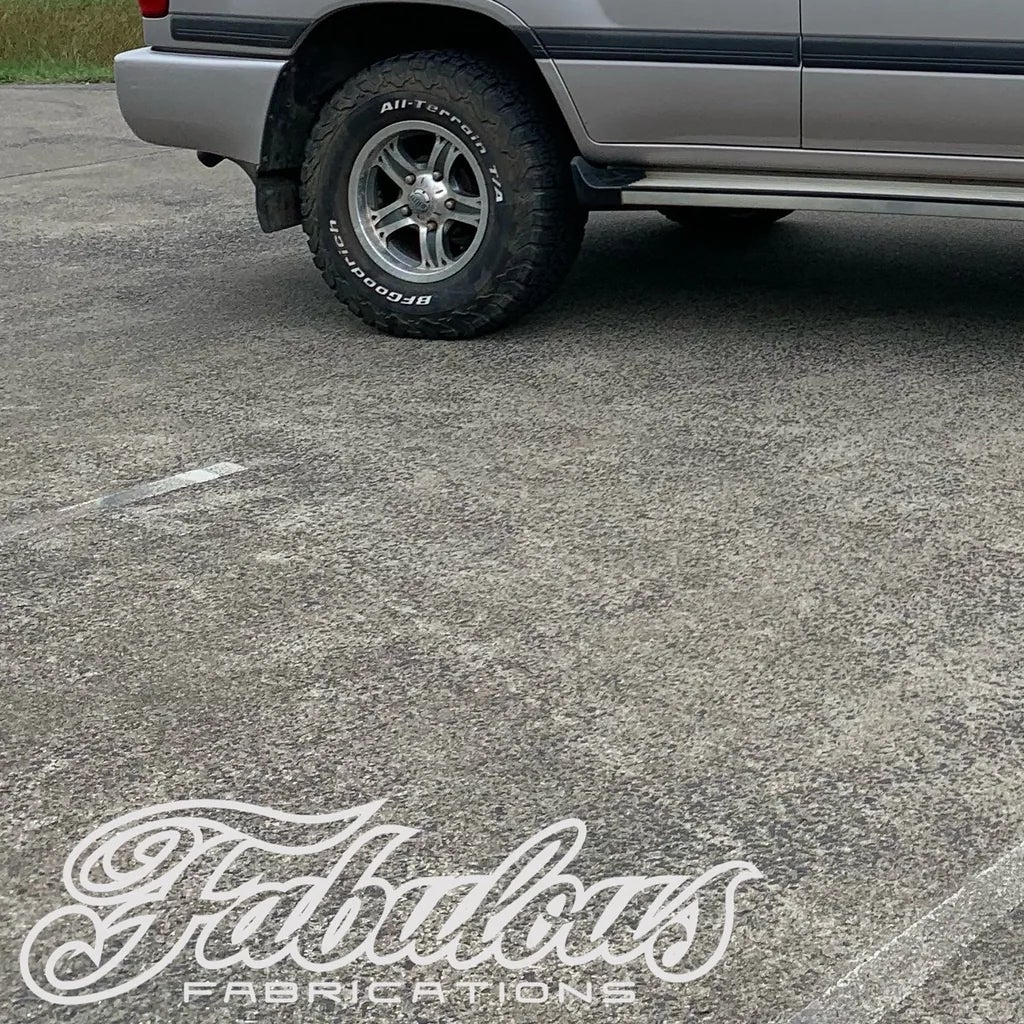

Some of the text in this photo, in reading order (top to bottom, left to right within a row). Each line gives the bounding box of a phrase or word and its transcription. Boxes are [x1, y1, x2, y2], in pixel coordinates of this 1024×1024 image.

[380, 99, 504, 203] All-Terrain T/A
[329, 219, 433, 307] BFGoodrich
